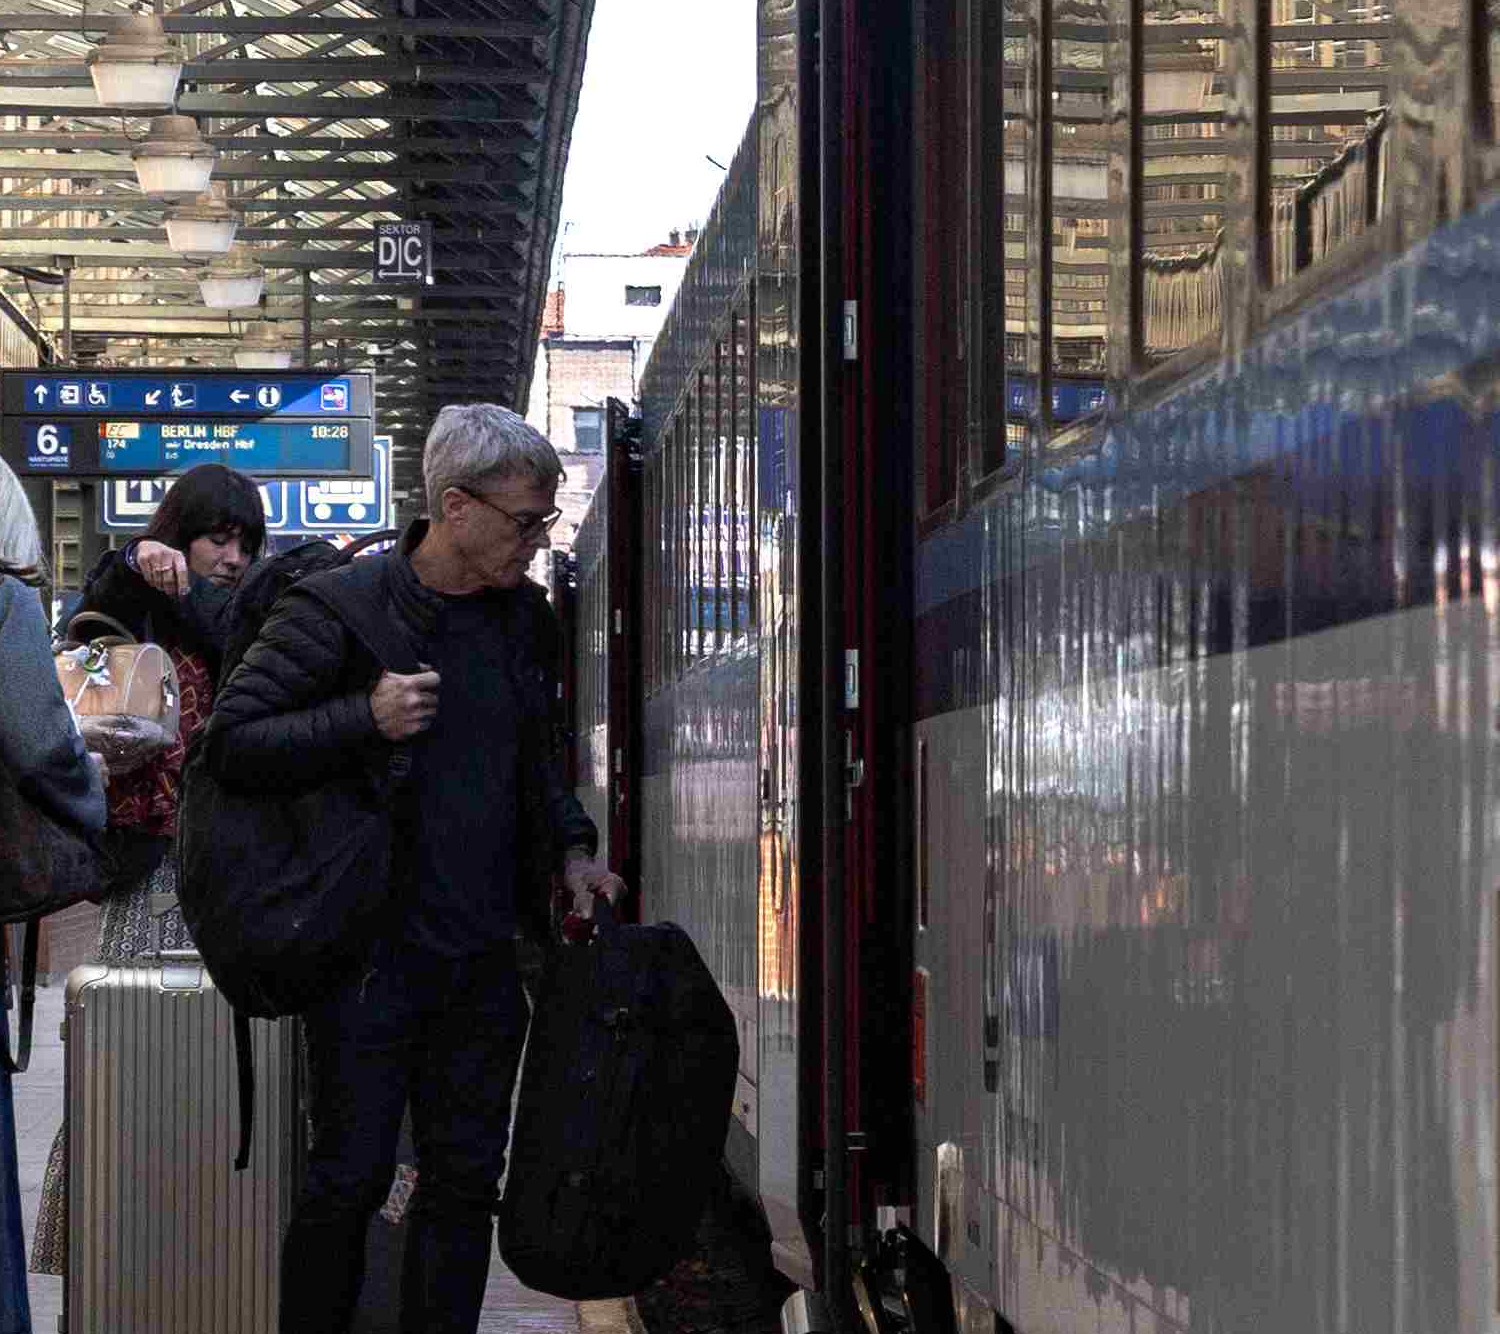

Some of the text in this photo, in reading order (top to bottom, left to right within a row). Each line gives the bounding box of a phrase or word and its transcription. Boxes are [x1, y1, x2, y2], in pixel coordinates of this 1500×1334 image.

[37, 424, 68, 455] 6.
[161, 425, 206, 438] BERLIN
[213, 425, 239, 438] HBF
[310, 425, 349, 439] 10:28
